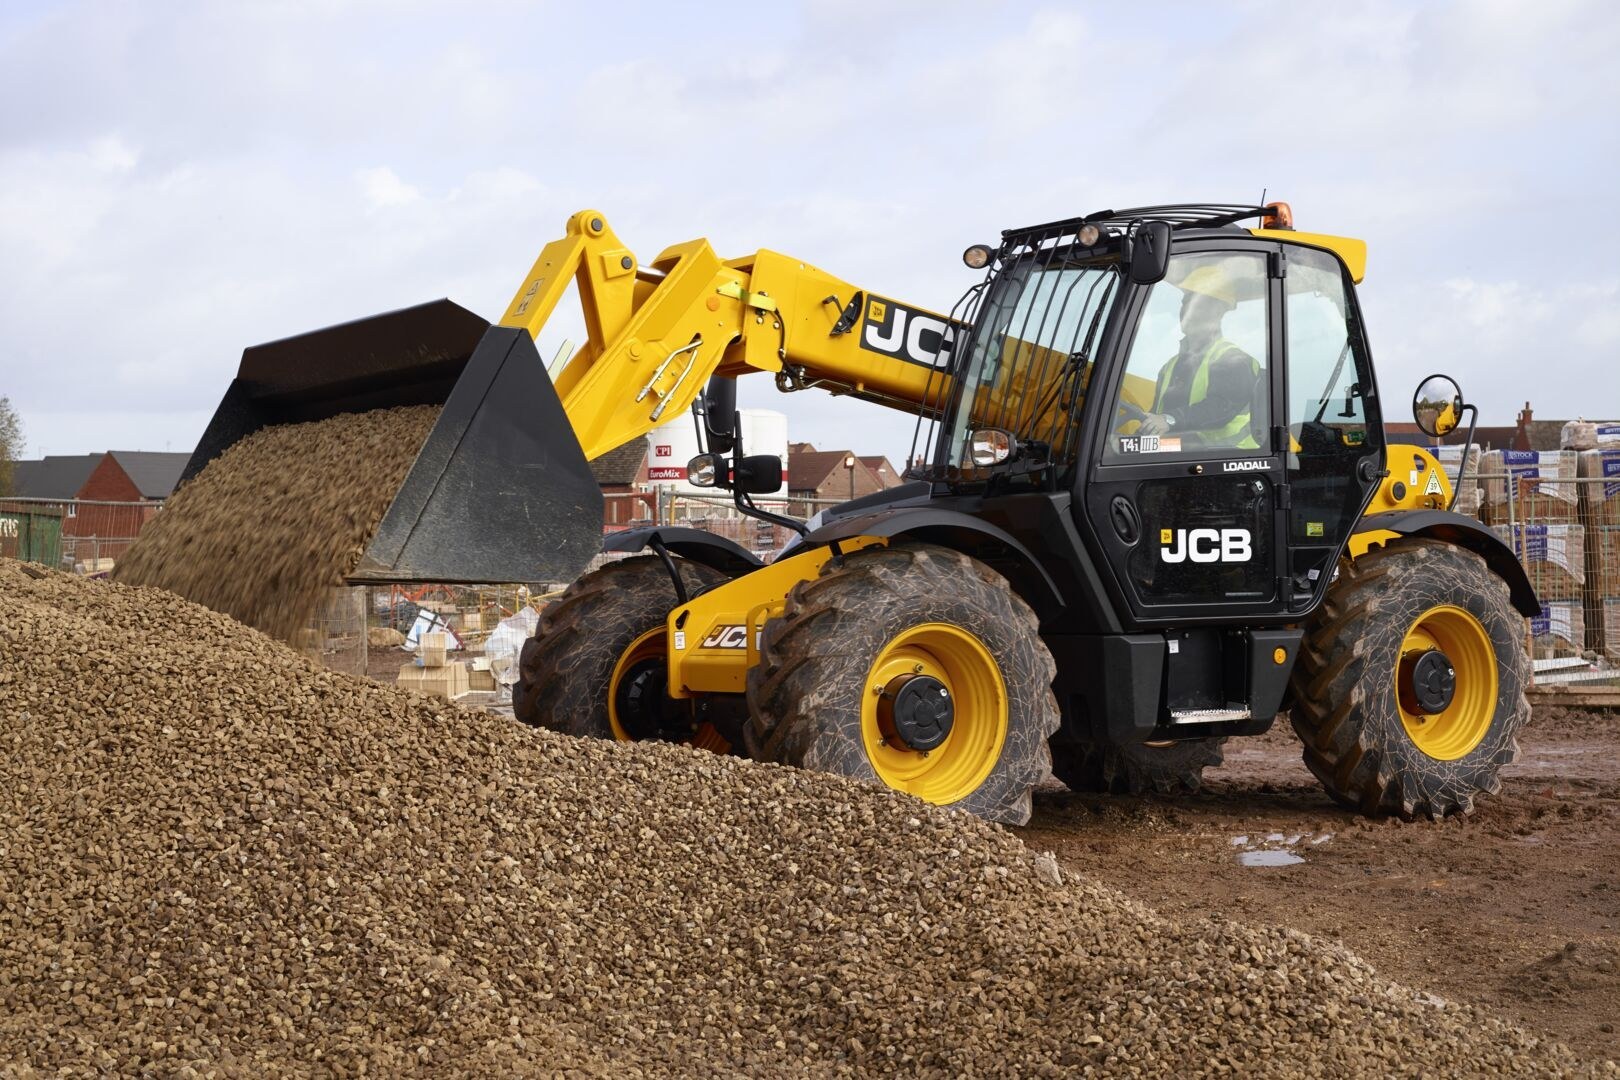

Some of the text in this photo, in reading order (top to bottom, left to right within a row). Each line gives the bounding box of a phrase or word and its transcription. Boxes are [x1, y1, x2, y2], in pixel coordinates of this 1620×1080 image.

[656, 446, 670, 456] CPI
[1120, 438, 1140, 452] T4i
[1223, 460, 1271, 472] LOADALL
[650, 469, 680, 479] EuroMix
[1160, 528, 1252, 563] JCB
[703, 626, 747, 648] JC
